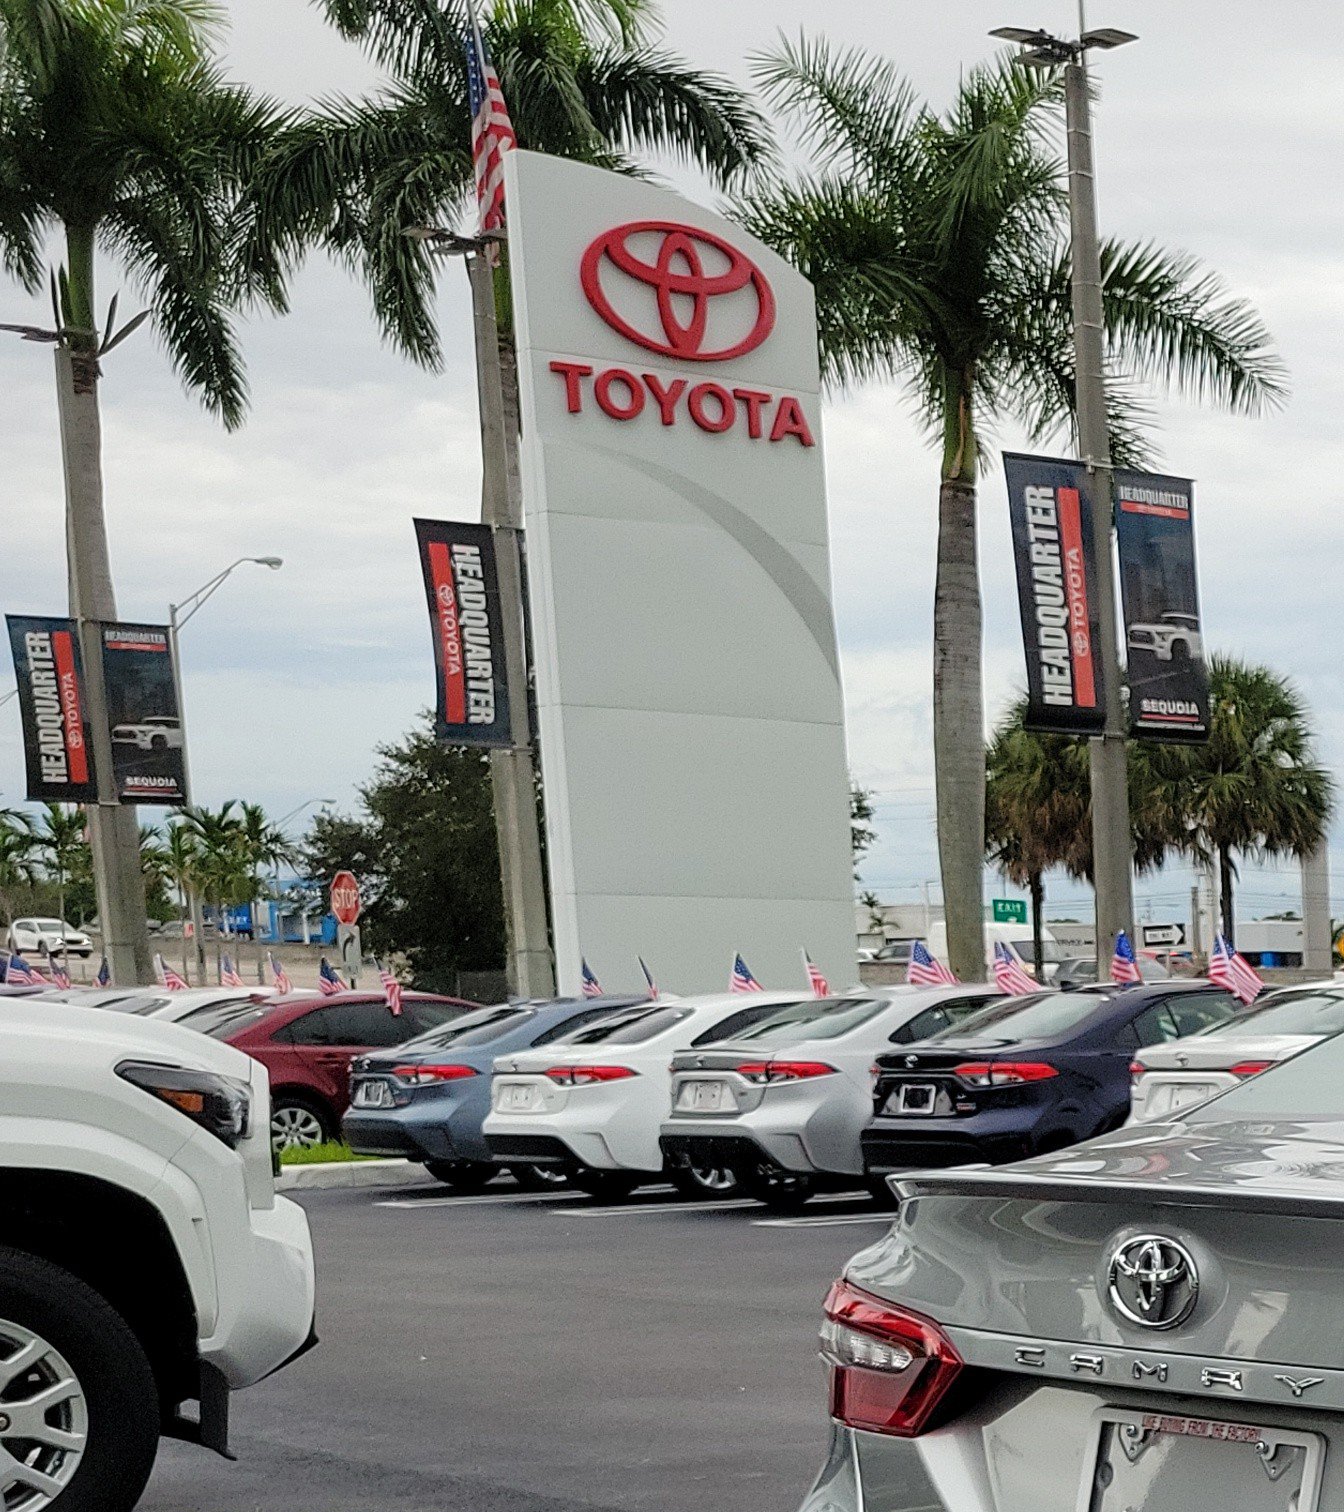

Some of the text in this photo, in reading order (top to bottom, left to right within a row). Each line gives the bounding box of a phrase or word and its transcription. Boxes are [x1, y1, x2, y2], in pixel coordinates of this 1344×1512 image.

[549, 361, 815, 447] TOYOTA
[1024, 485, 1073, 706] HEADQUARTER
[1065, 548, 1087, 629] TOYOTA
[442, 607, 461, 676] TOYOTA
[452, 543, 495, 724] HEADQUARTER
[25, 631, 68, 783] HEADQUARTER
[62, 672, 80, 730] TOYOTA
[1141, 699, 1200, 715] SEQUOIA
[125, 776, 177, 787] SEQUOIA
[333, 888, 358, 908] STOP
[1015, 1346, 1325, 1397] CAMRY
